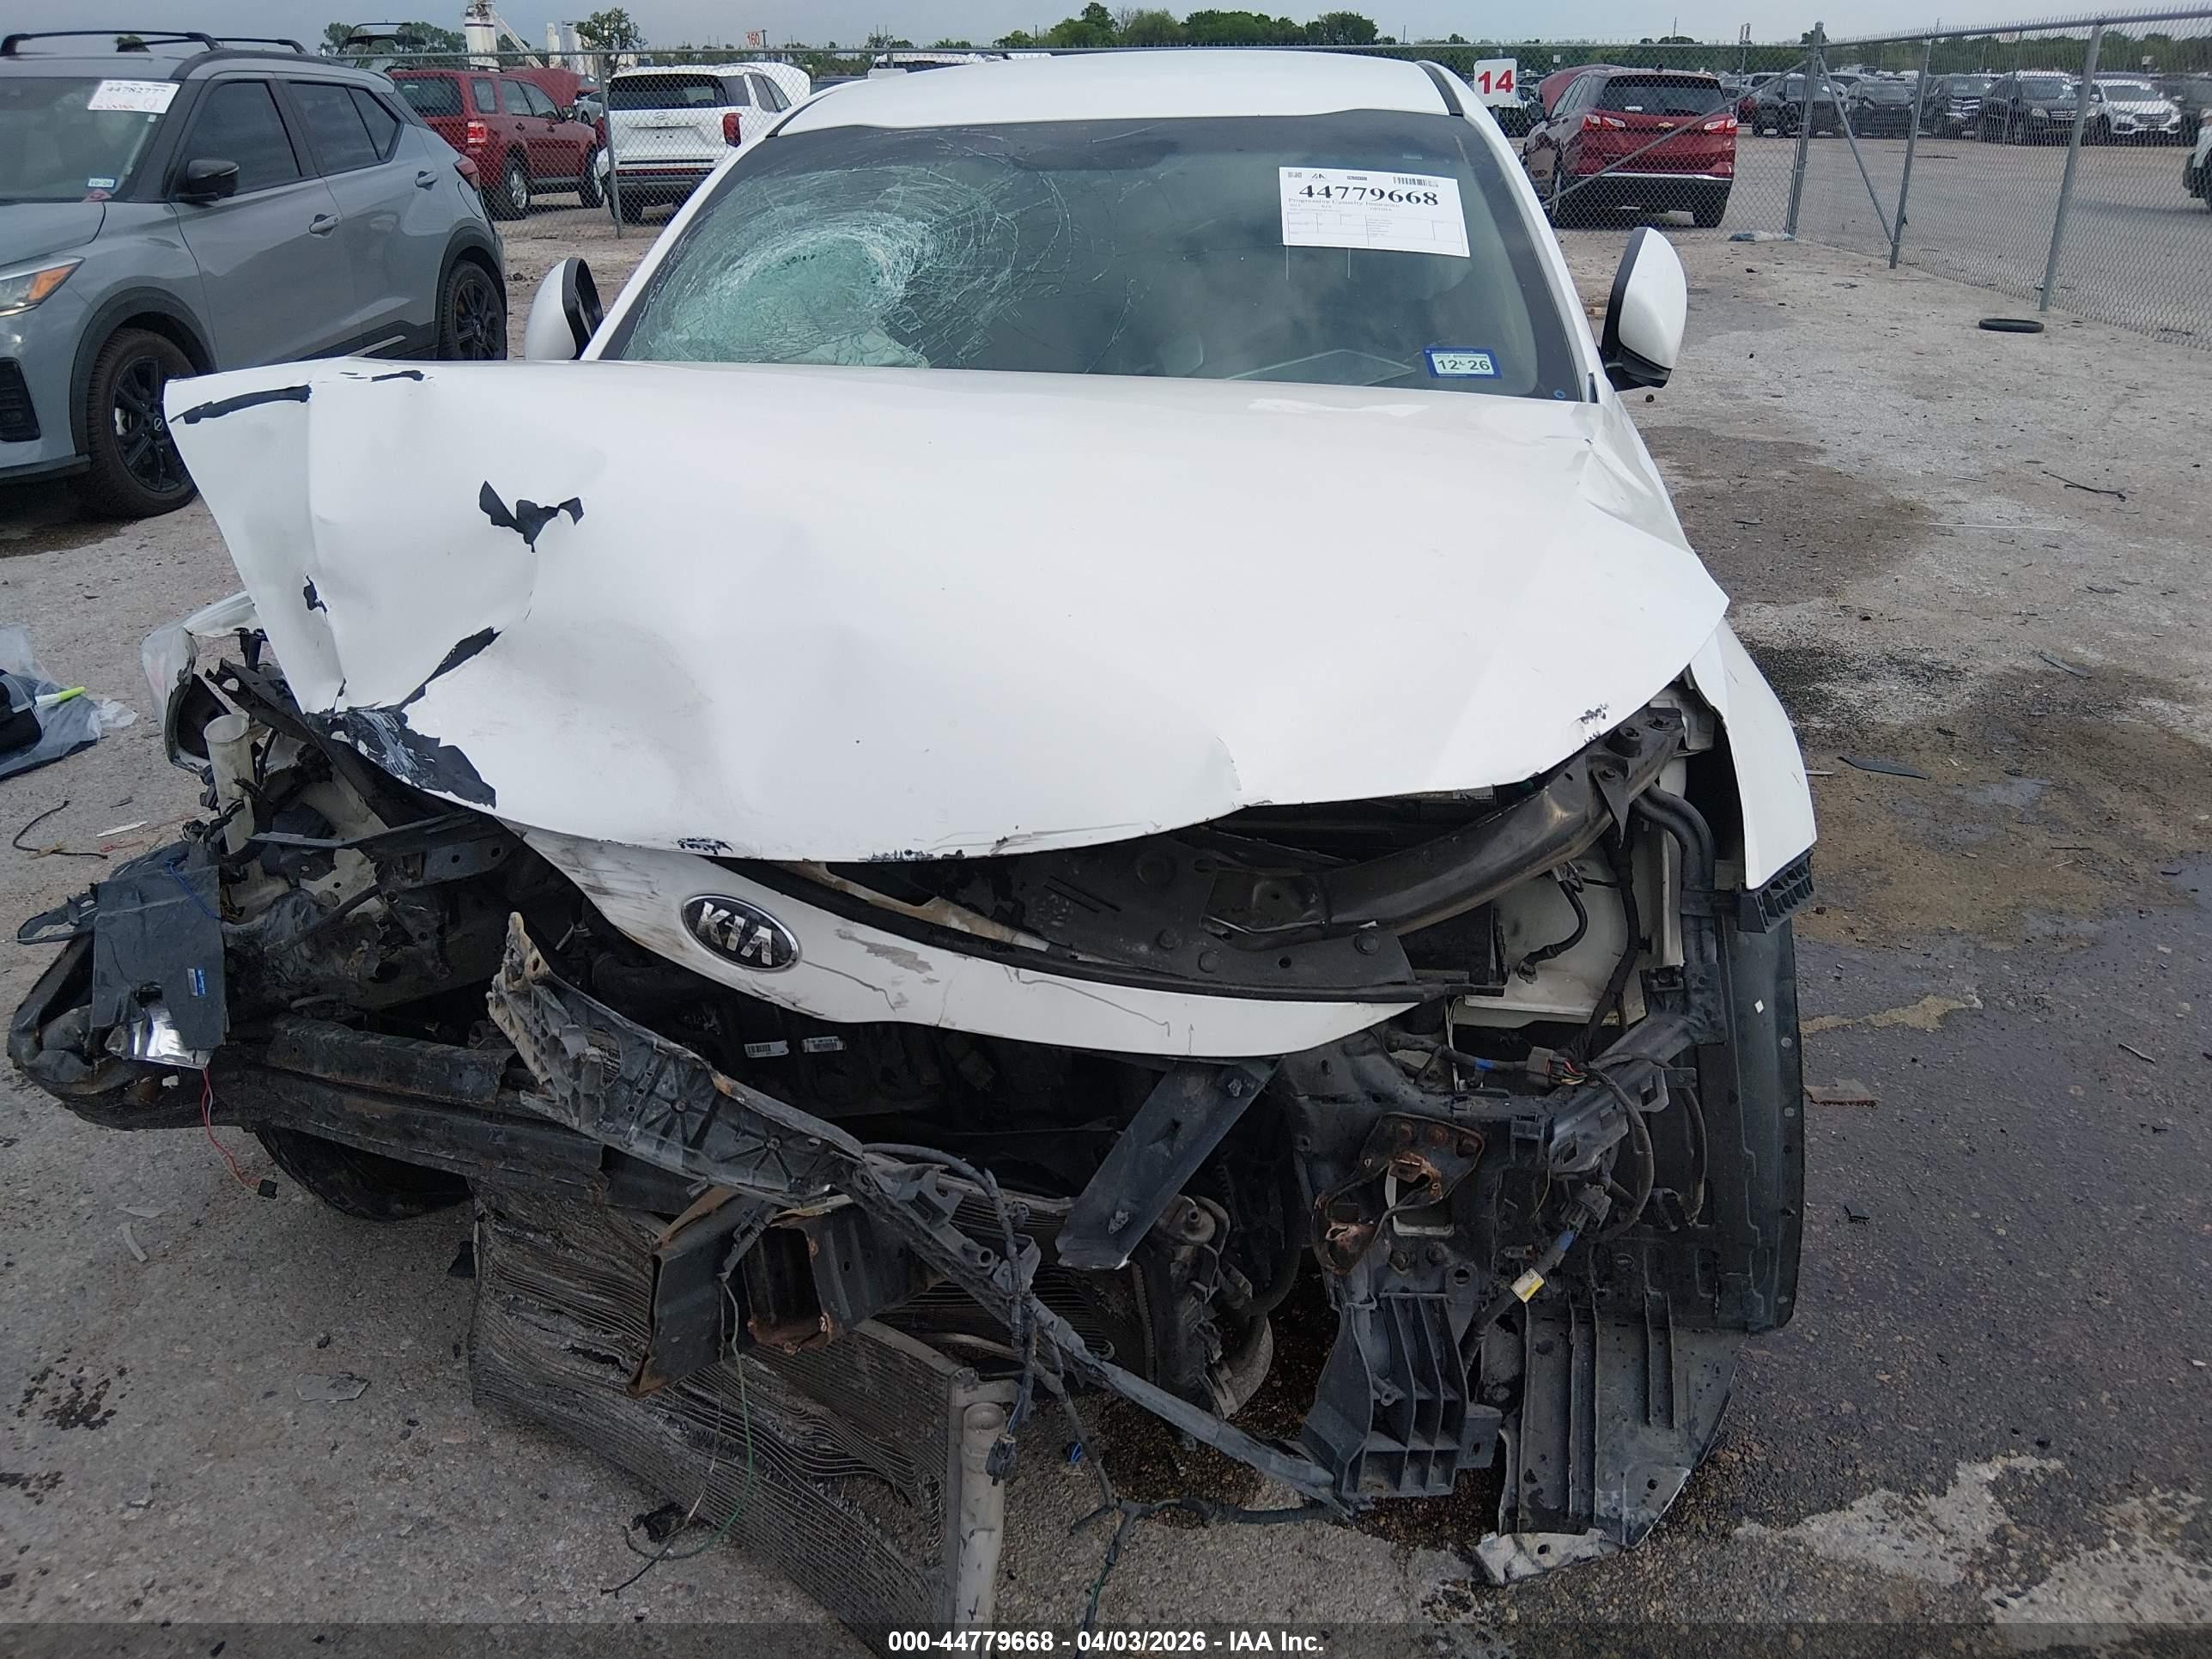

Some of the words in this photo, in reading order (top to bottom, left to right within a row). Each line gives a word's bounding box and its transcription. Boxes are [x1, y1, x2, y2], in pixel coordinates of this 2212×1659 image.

[1478, 70, 1514, 94] 14
[1299, 185, 1439, 206] 44779668
[1438, 360, 1460, 370] 12
[1468, 360, 1490, 371] 26
[696, 901, 773, 966] KIA
